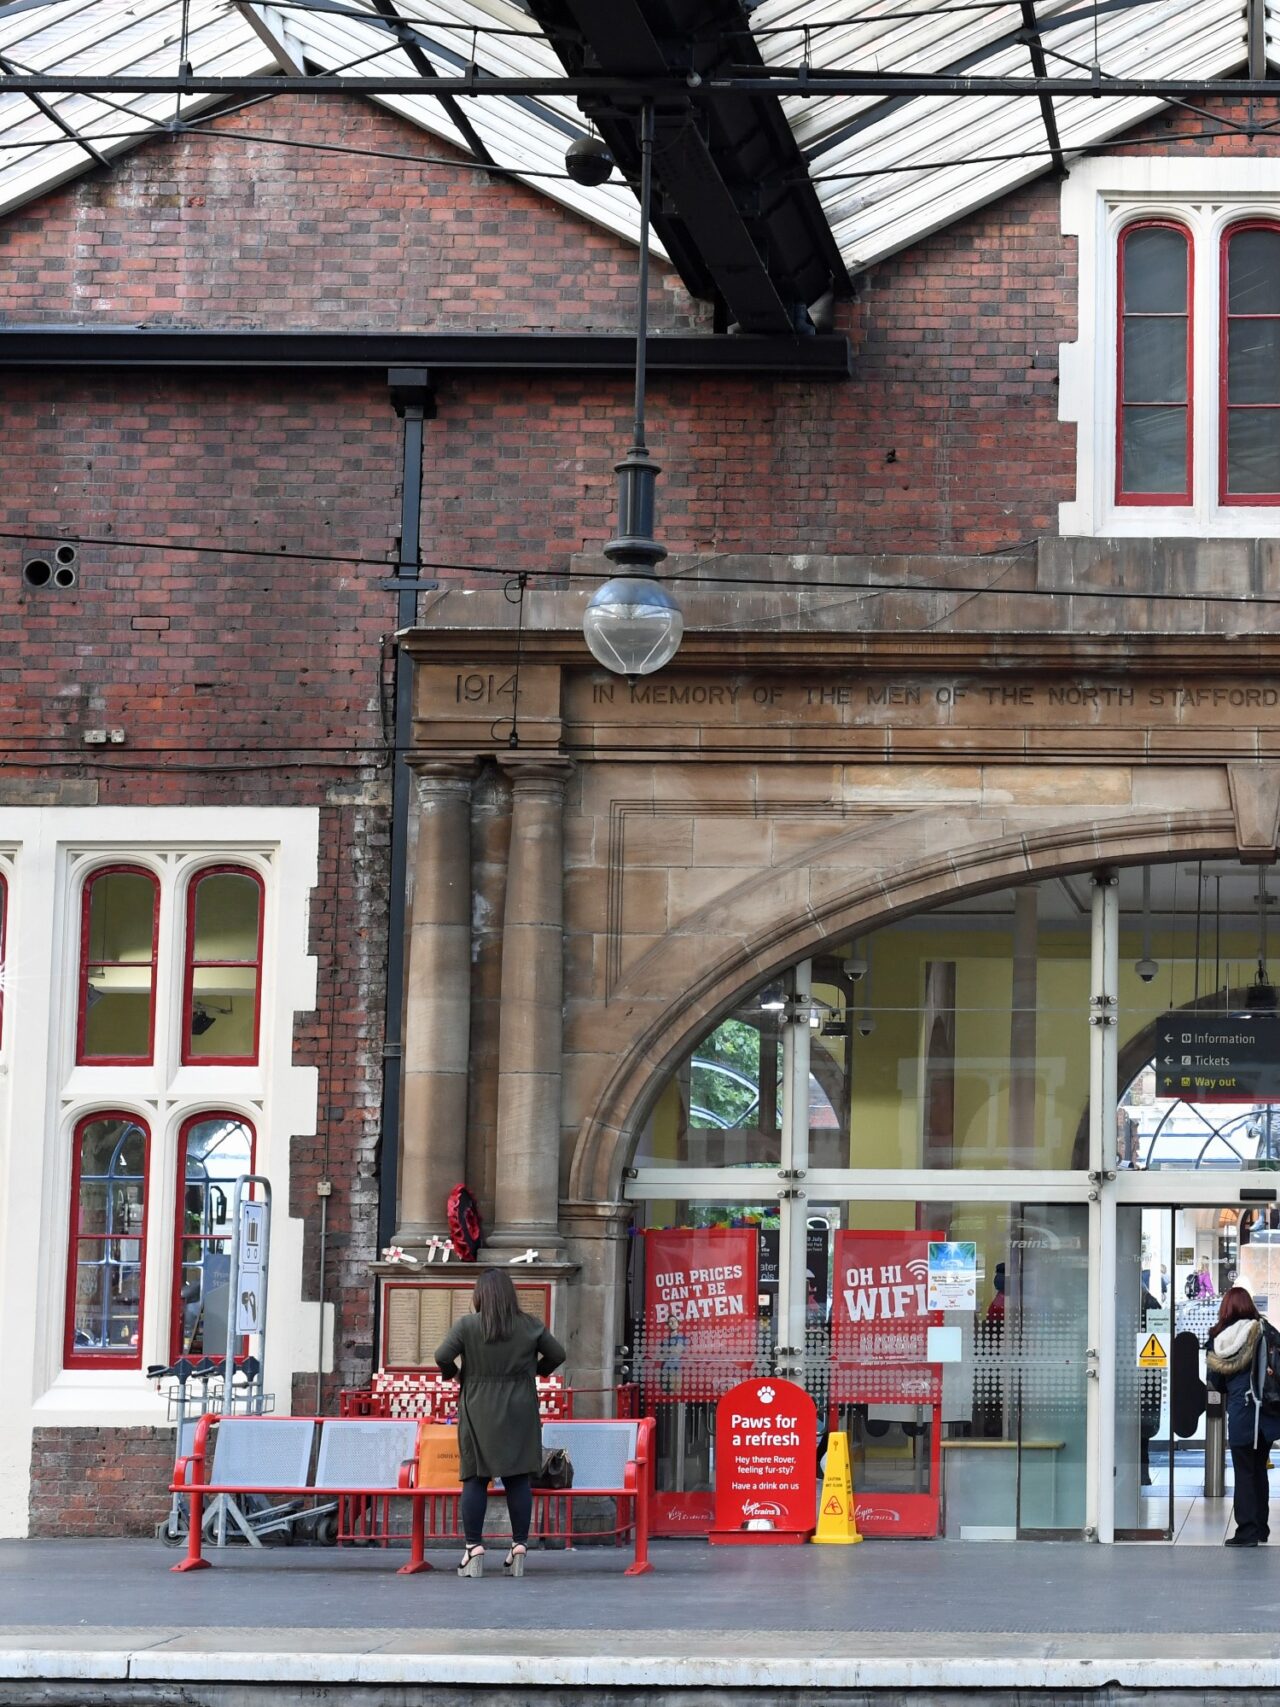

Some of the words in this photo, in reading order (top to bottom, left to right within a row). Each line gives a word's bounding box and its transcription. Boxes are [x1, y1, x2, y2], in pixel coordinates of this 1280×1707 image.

[455, 673, 522, 704] 1914
[592, 684, 615, 704] IN
[630, 684, 742, 705] MEMORY
[752, 685, 785, 705] OF
[801, 686, 854, 706] THE
[865, 686, 921, 706] MEN
[935, 686, 969, 706] OF
[982, 687, 1034, 706] THE
[1048, 687, 1135, 707] NORTH
[1194, 1033, 1256, 1044] Information
[1194, 1055, 1230, 1066] Tickets
[1194, 1077, 1215, 1088] Way
[1219, 1077, 1236, 1087] out
[655, 1271, 685, 1288] OUR
[689, 1264, 743, 1284] PRICES
[846, 1267, 874, 1287] OH
[880, 1265, 902, 1284] HI
[661, 1285, 702, 1301] CAN'T
[707, 1282, 726, 1296] BE
[655, 1294, 744, 1324] BEATEN
[843, 1284, 928, 1322] WIFI
[731, 1414, 771, 1429] Paws
[775, 1413, 798, 1429] for
[732, 1434, 741, 1446] a
[745, 1431, 800, 1446] refresh
[735, 1455, 750, 1465] Hey
[752, 1455, 772, 1464] there
[773, 1455, 797, 1465] Rover,
[737, 1465, 764, 1476] feeling
[765, 1465, 794, 1476] fur-sty?
[731, 1482, 751, 1490] Have
[758, 1482, 777, 1490] drink
[742, 1499, 760, 1516] Virgin
